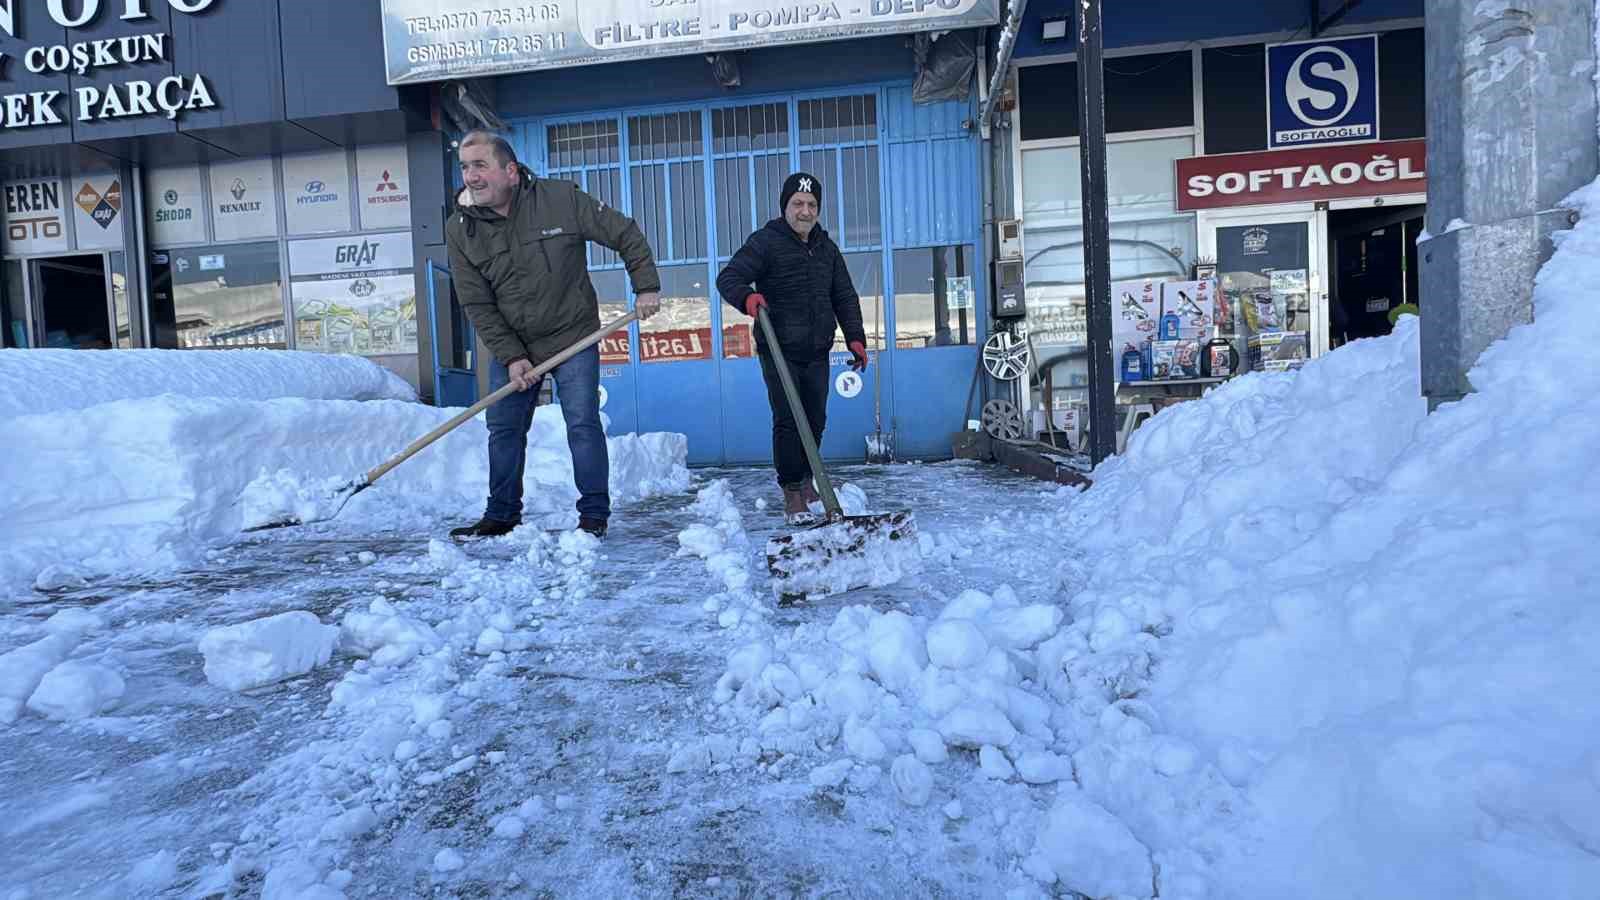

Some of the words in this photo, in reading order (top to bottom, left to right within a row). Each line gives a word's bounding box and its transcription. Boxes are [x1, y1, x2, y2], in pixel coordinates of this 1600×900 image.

[594, 17, 701, 46] FİLTRE
[729, 6, 841, 31] POMPA
[24, 33, 166, 75] COŞKUN
[488, 37, 519, 55] 782
[523, 35, 544, 52] 85
[550, 32, 567, 49] 11
[0, 90, 62, 128] EK
[75, 73, 215, 121] PARÇA
[1280, 127, 1368, 142] SOFTAOĞLU
[5, 181, 59, 213] EREN
[219, 200, 262, 214] RENAULT
[8, 216, 61, 241] OTO
[335, 239, 380, 267] GRAT
